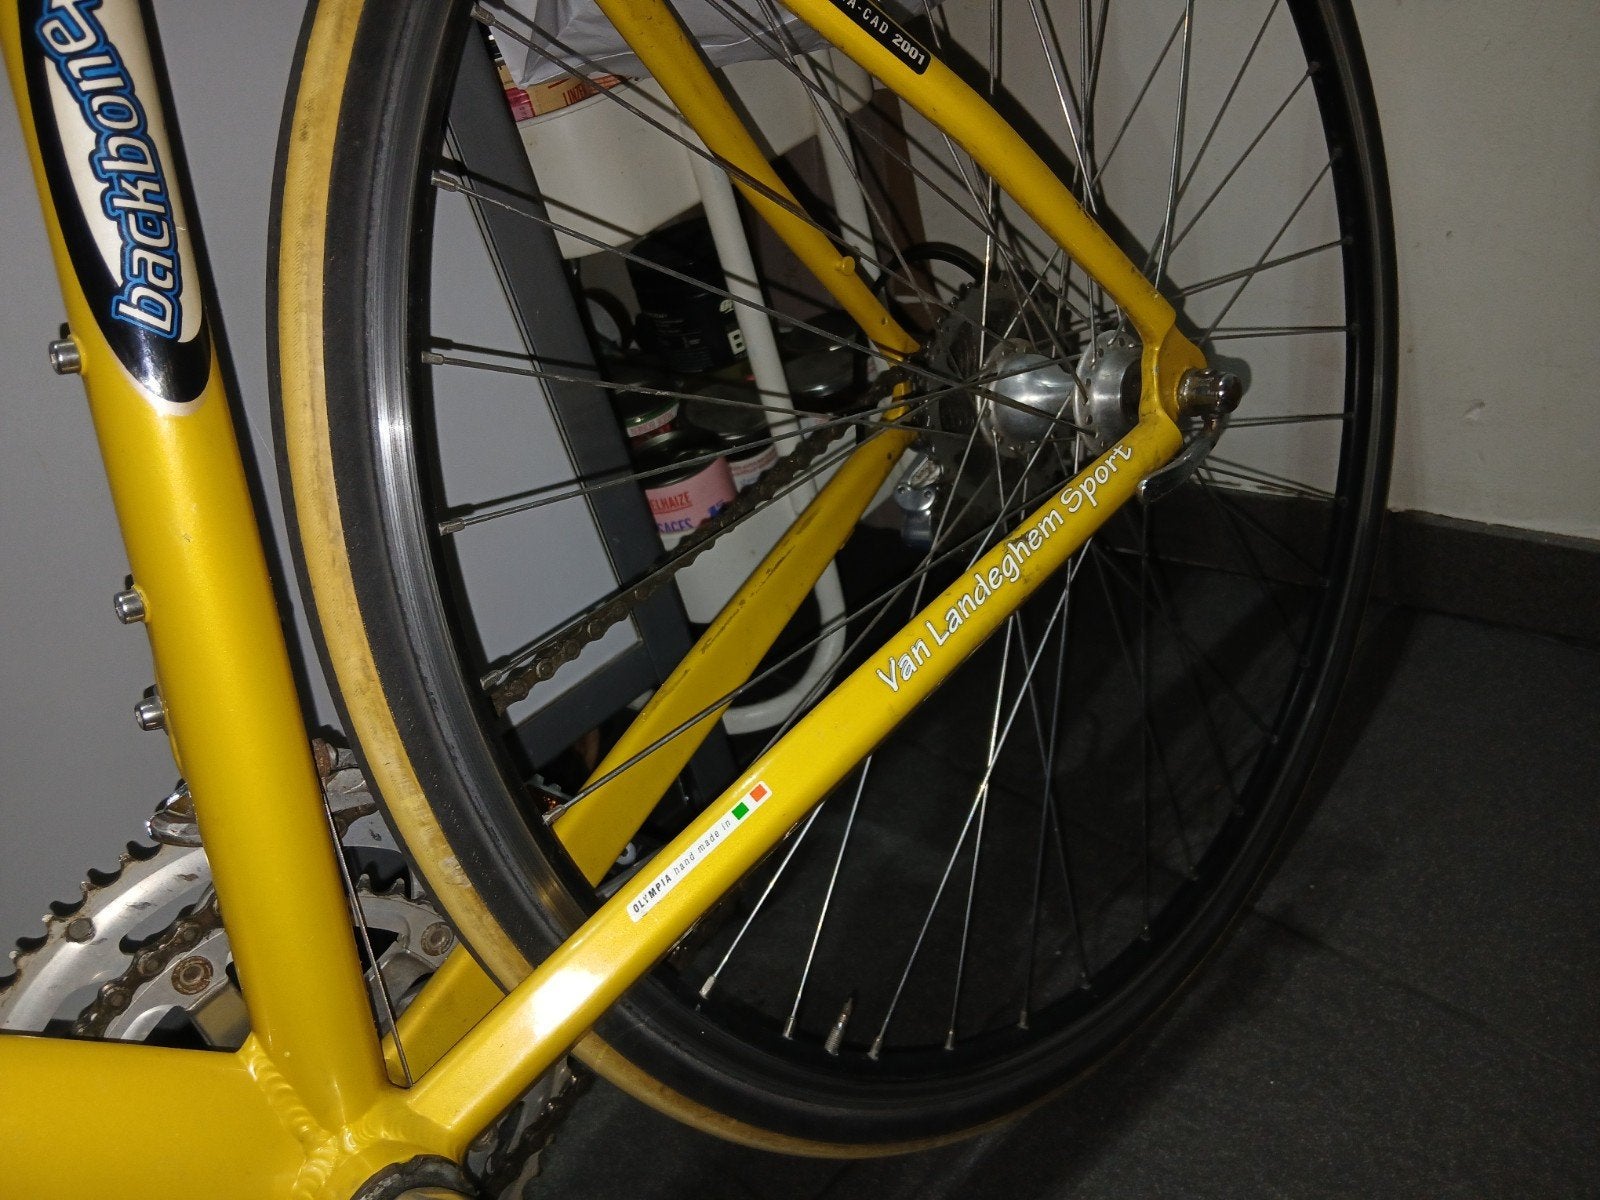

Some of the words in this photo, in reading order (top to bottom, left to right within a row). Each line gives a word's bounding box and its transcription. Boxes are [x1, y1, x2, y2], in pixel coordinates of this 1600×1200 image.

[842, 0, 889, 34] A-CAD
[891, 33, 925, 66] 2001
[37, 0, 179, 336] backbone
[876, 638, 931, 692] Van
[926, 508, 1064, 647] Landeghem
[1060, 444, 1133, 514] Sport
[632, 874, 673, 913] OLYMPIA
[673, 852, 695, 876] hand
[697, 830, 720, 855] made
[721, 819, 731, 831] in
